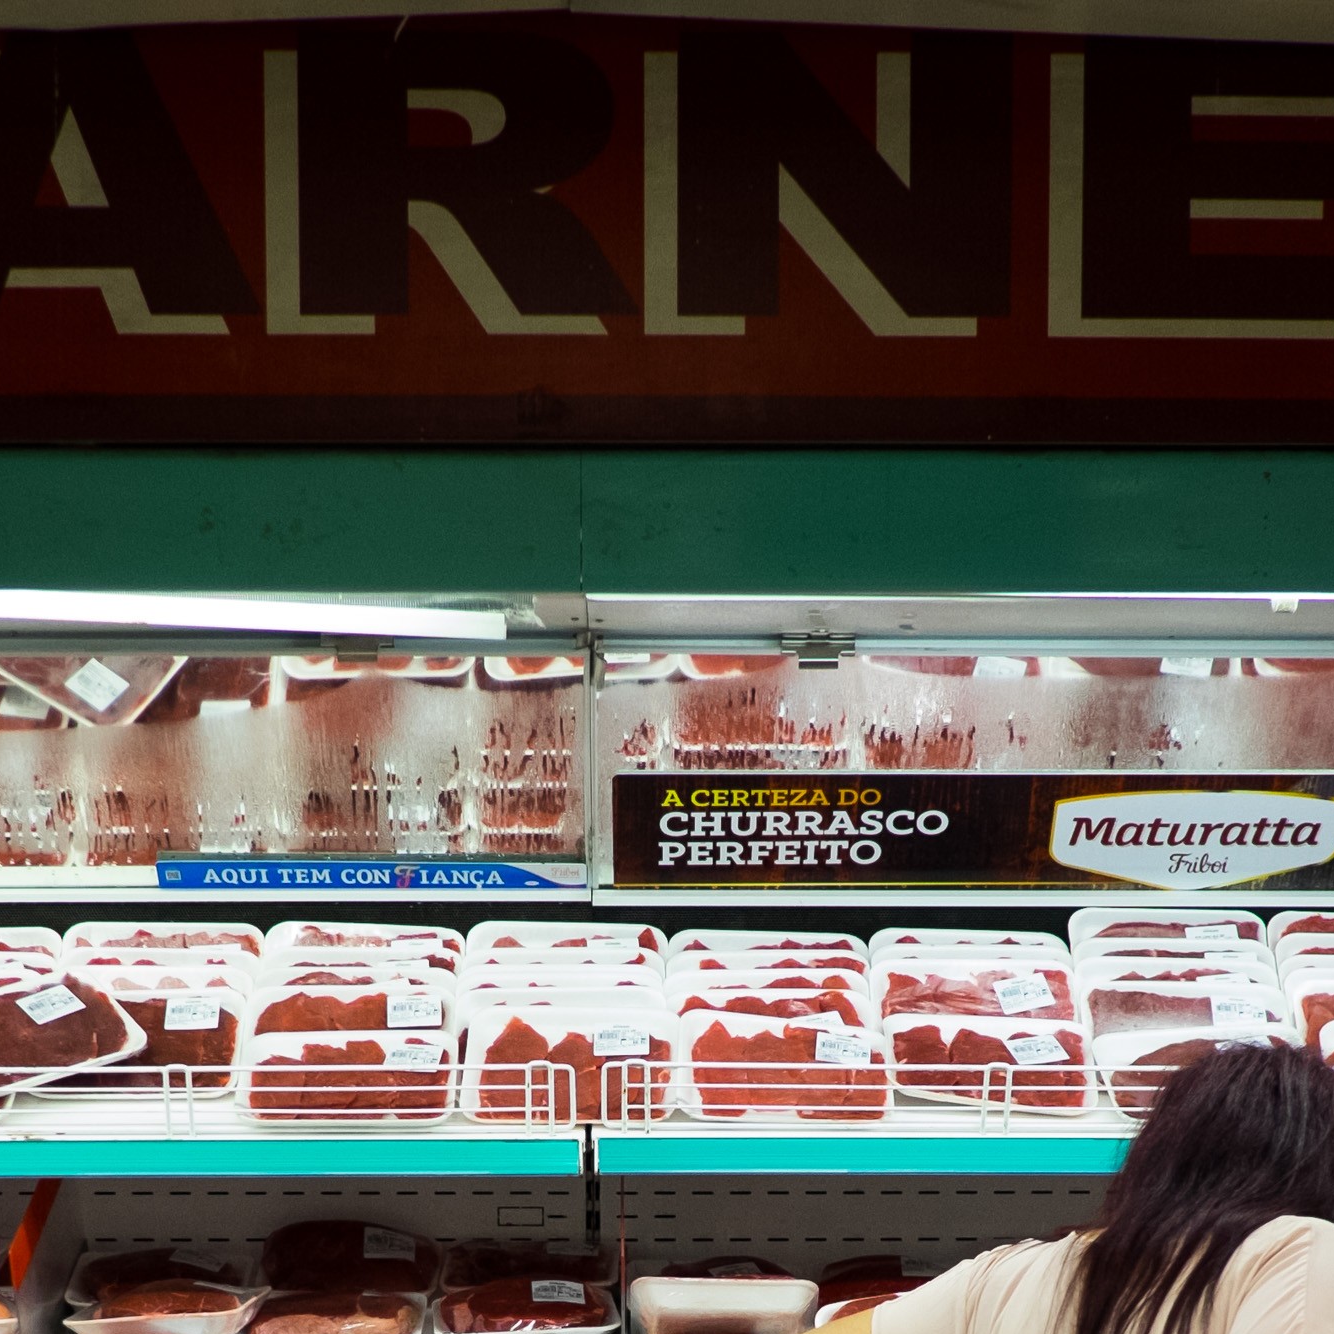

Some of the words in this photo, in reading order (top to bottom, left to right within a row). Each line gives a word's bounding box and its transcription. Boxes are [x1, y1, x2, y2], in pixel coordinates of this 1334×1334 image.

[661, 789, 684, 807] A
[691, 789, 831, 807] CERTEZA
[837, 788, 882, 806] DO
[659, 810, 950, 837] CHURRASCO
[1068, 816, 1322, 847] Maturatta
[658, 839, 883, 866] PERFEITO
[1168, 853, 1229, 874] Friboi
[203, 868, 268, 886] AQUI
[278, 868, 332, 885] TEM
